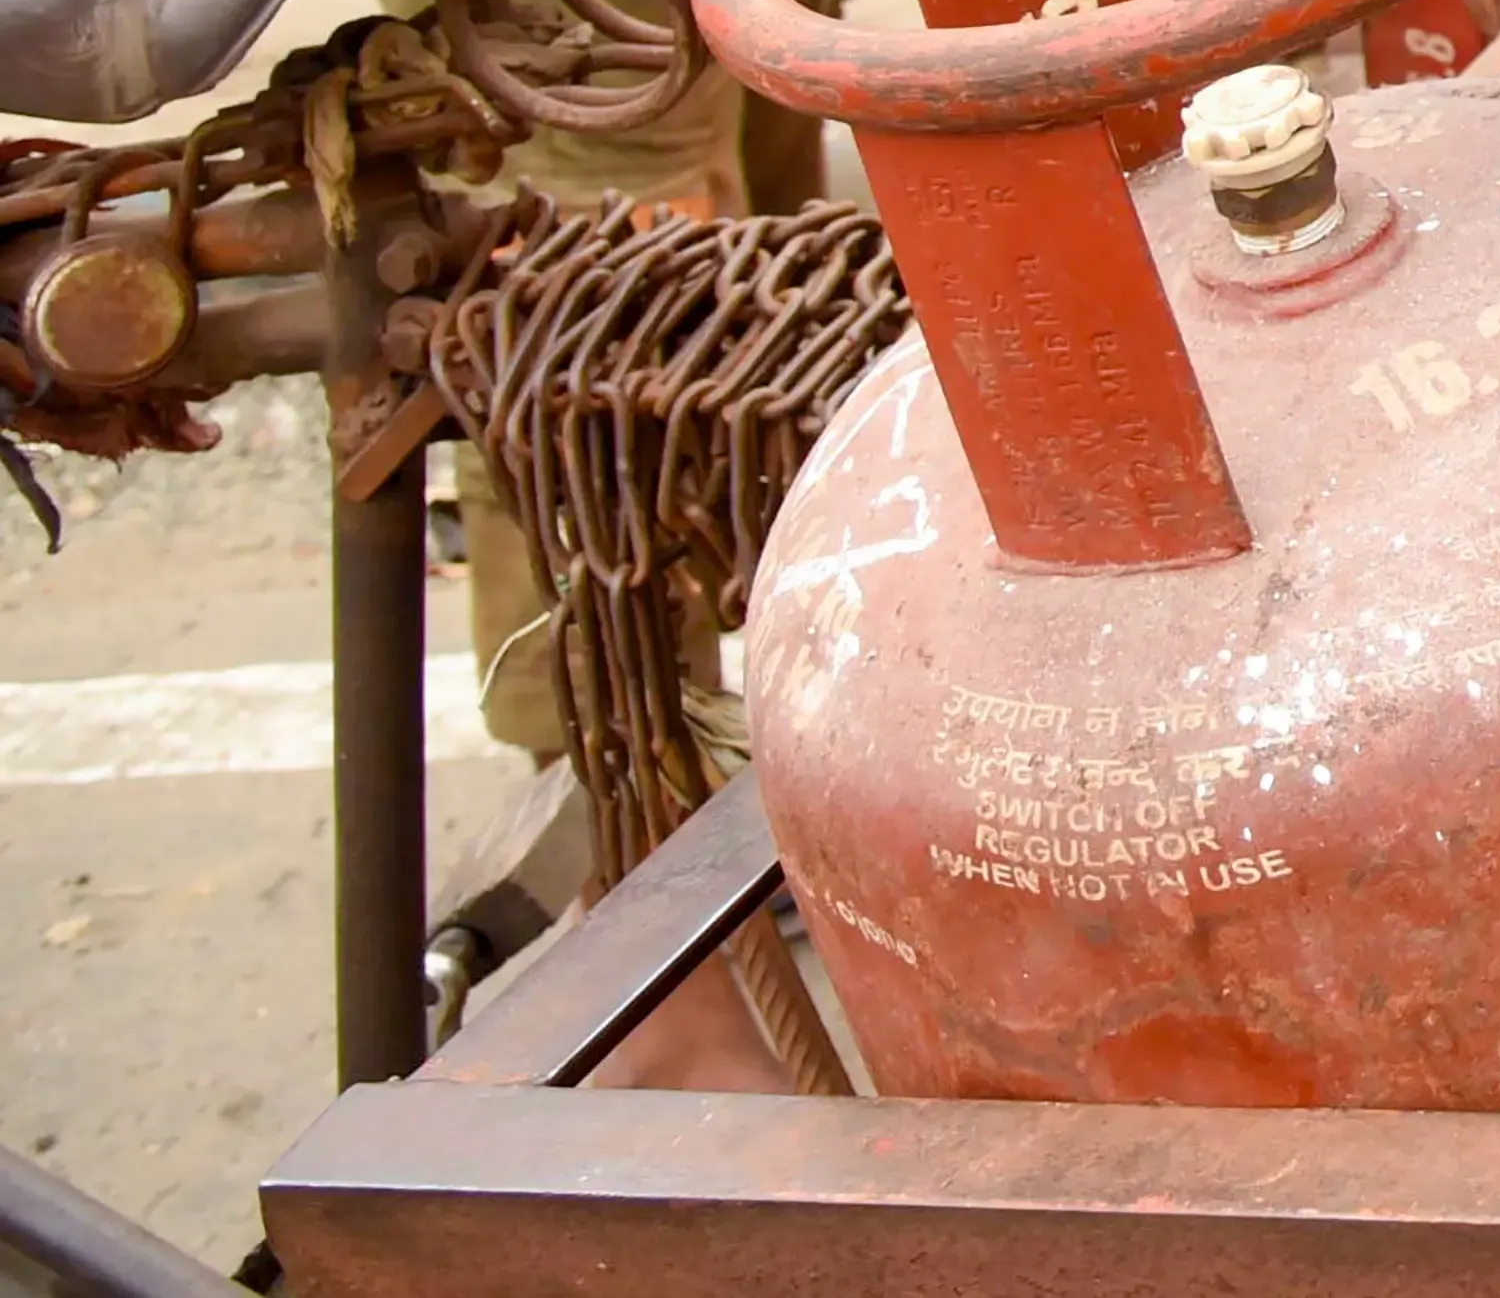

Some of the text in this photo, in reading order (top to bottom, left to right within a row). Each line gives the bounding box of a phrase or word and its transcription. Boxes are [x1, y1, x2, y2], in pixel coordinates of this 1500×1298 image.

[975, 790, 1218, 833] SWITCH OFF
[929, 842, 1041, 895] WHEN
[1200, 848, 1294, 893] USE
[975, 823, 1222, 869] REGULATOR
